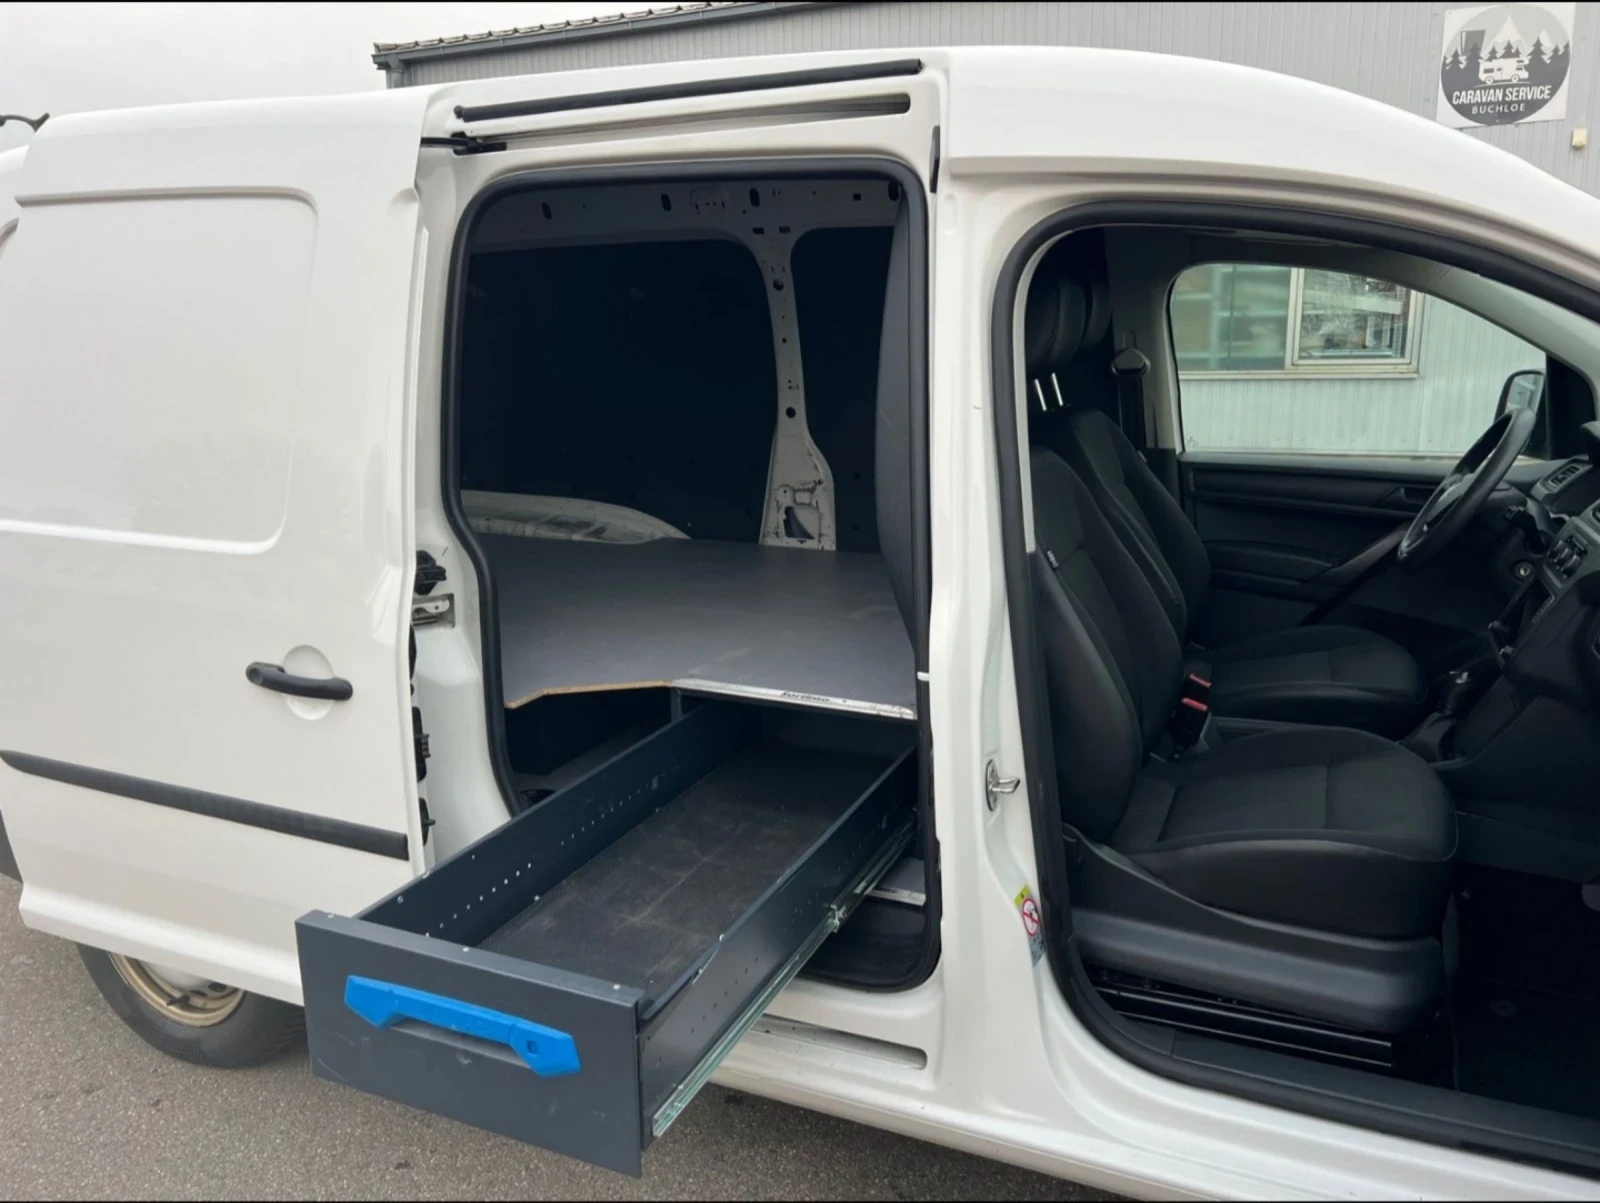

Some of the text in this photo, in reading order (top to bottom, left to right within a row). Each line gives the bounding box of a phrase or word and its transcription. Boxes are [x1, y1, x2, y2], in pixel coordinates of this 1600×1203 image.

[1452, 85, 1552, 105] CARAVAN SERVICE
[1472, 103, 1526, 114] BUCHLOE
